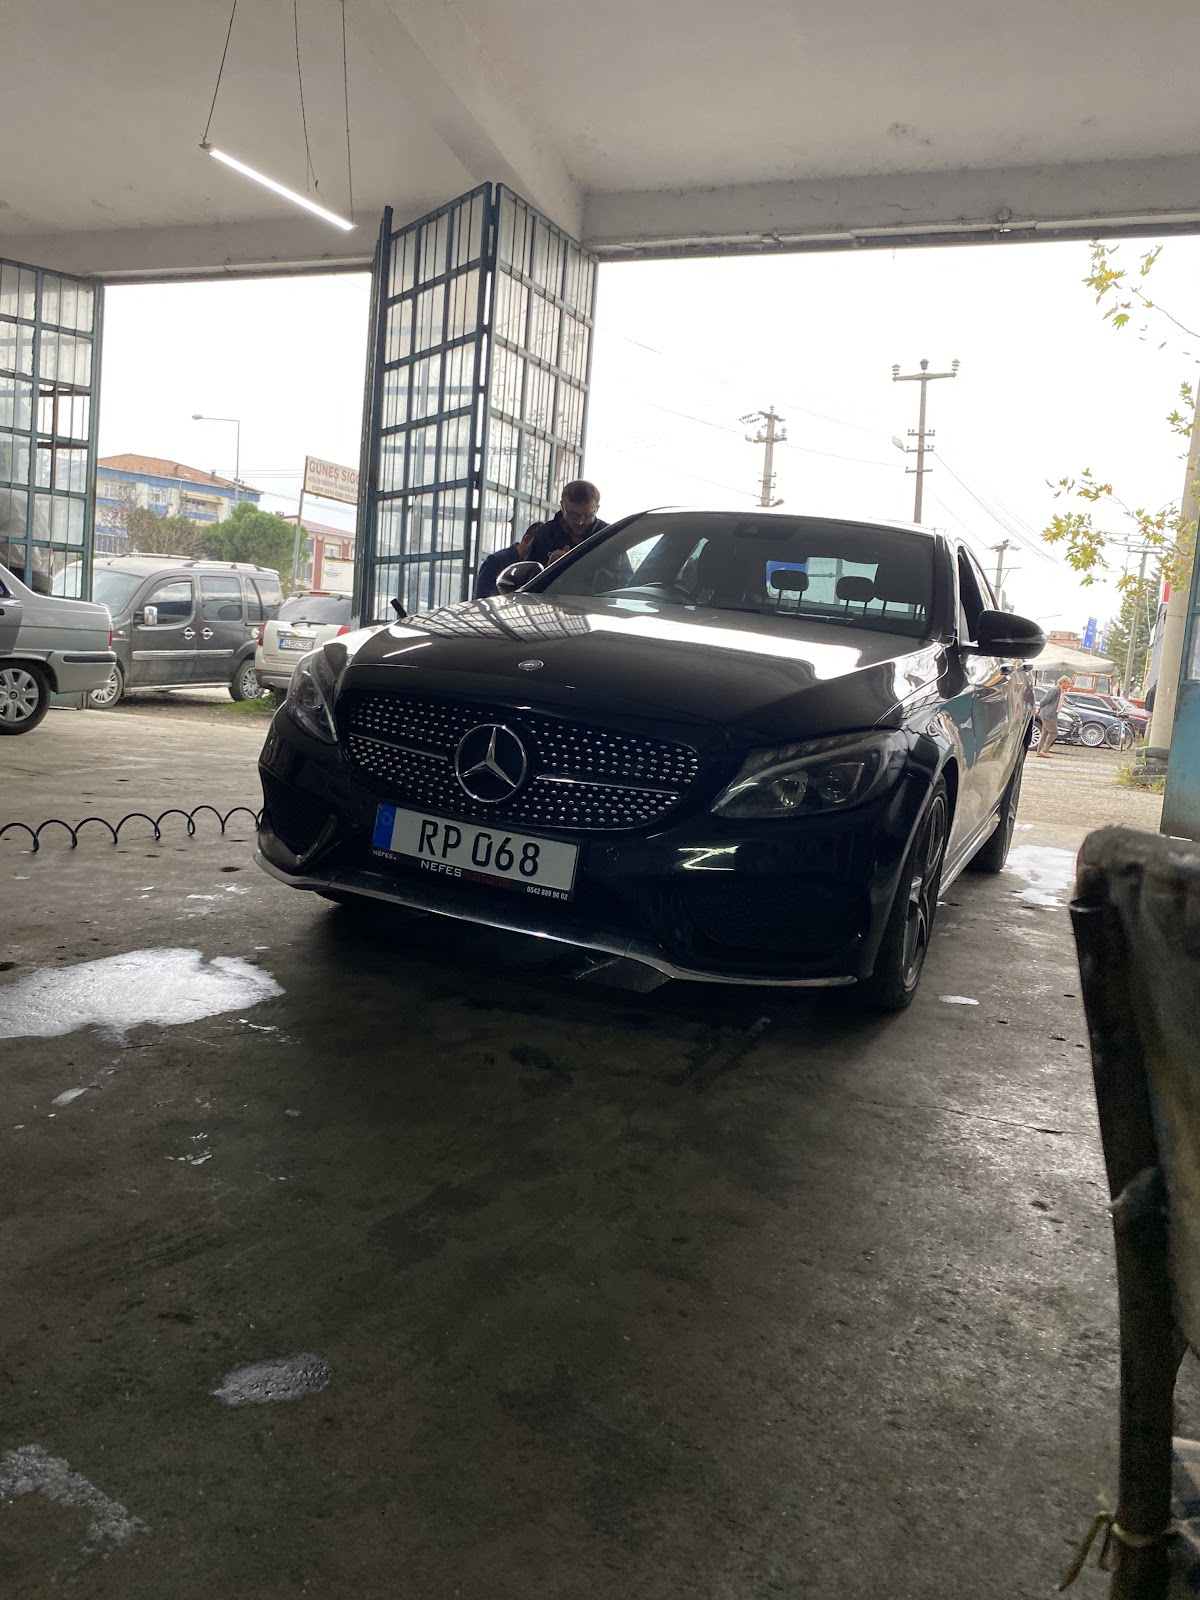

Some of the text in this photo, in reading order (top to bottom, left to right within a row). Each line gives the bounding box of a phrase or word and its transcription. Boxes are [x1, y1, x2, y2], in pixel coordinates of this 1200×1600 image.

[418, 819, 540, 877] RP 068
[420, 859, 462, 878] NEFES
[526, 885, 541, 895] 0542
[560, 892, 568, 901] 02
